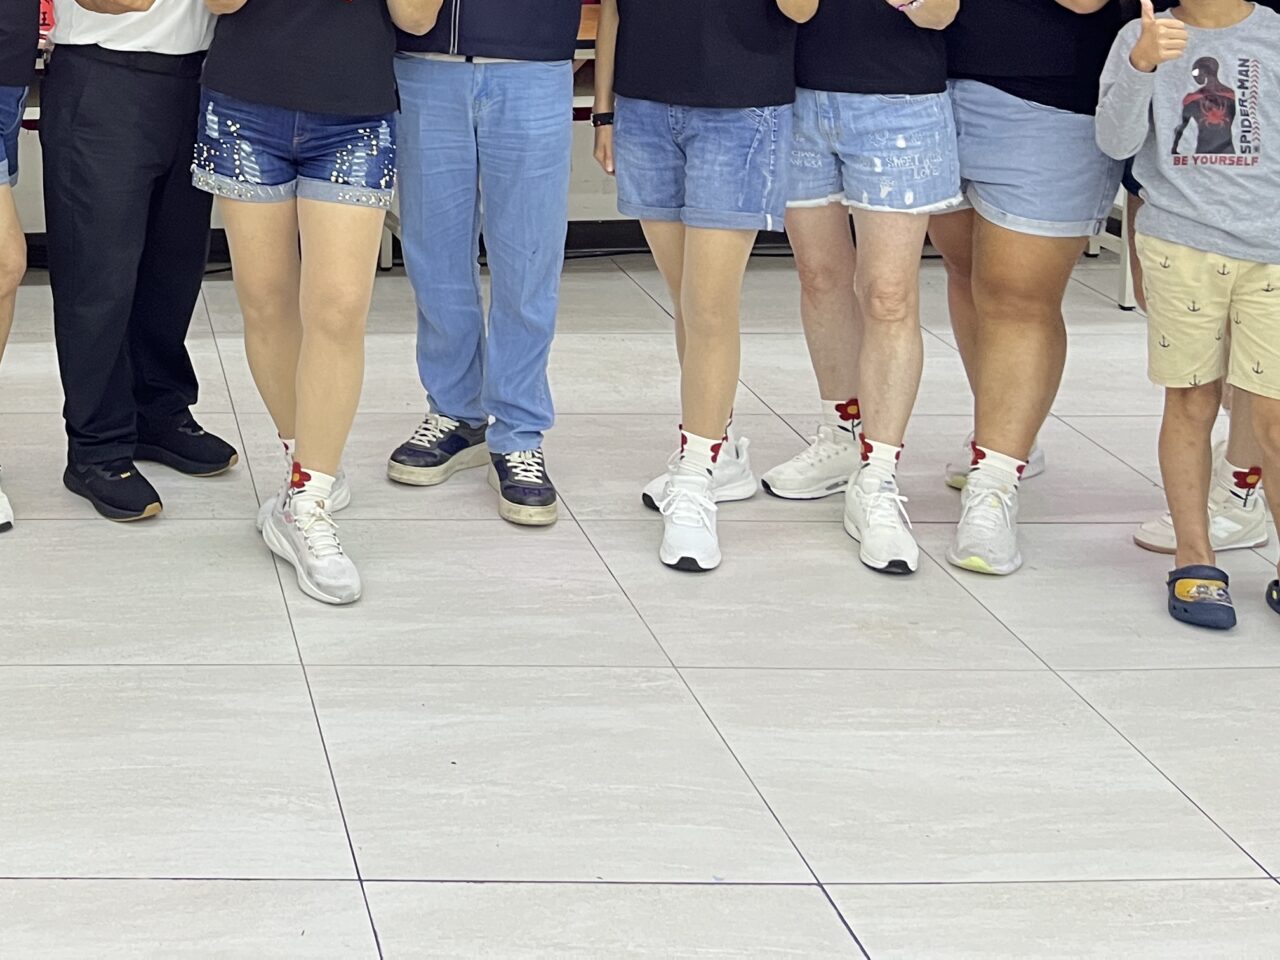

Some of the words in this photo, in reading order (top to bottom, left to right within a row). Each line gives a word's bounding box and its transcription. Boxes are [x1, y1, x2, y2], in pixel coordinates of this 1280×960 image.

[1237, 58, 1252, 154] SPIDER-MAN
[1173, 156, 1188, 166] BE
[1192, 156, 1259, 166] YOURSELF
